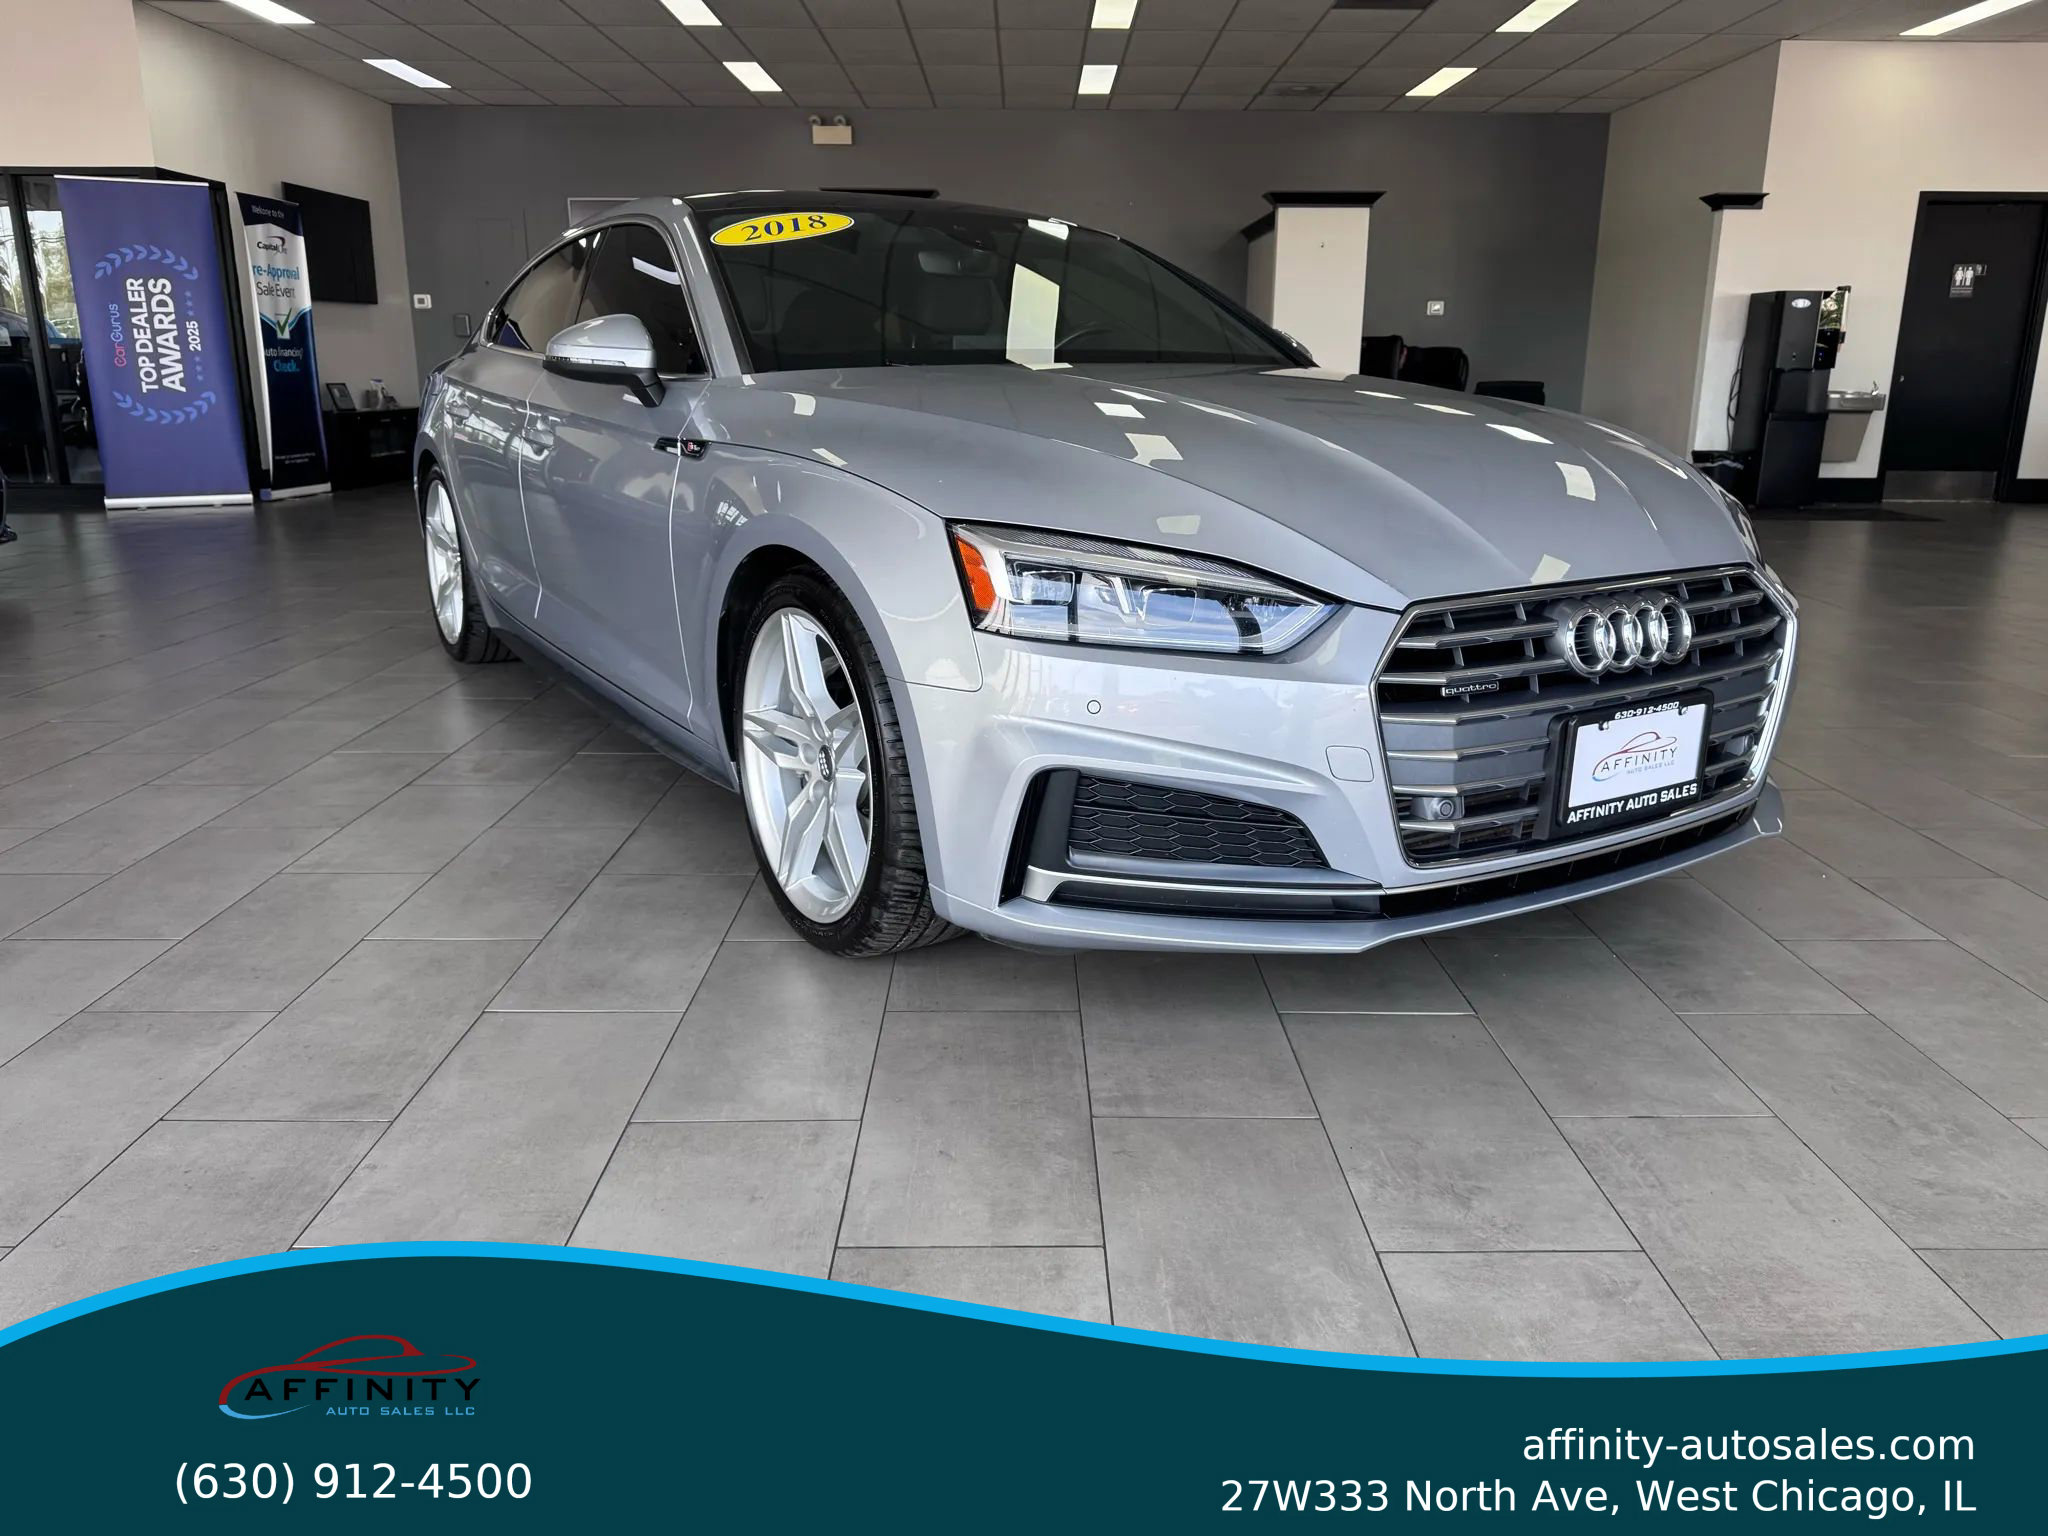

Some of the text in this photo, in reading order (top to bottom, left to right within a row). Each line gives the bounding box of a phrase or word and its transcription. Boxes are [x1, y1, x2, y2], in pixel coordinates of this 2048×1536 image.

[741, 214, 827, 242] 2018
[256, 281, 275, 296] Sale
[108, 303, 127, 367] CarGurus
[126, 278, 159, 393] TOP DEALER
[147, 278, 187, 393] AWARDS
[186, 320, 202, 352] 2025
[264, 348, 277, 357] uto
[1445, 683, 1497, 695] quattro
[1614, 701, 1680, 720] 630-912-4500
[1601, 747, 1678, 773] AFFINITY
[1566, 783, 1698, 824] AFFINITY AUTO SALES
